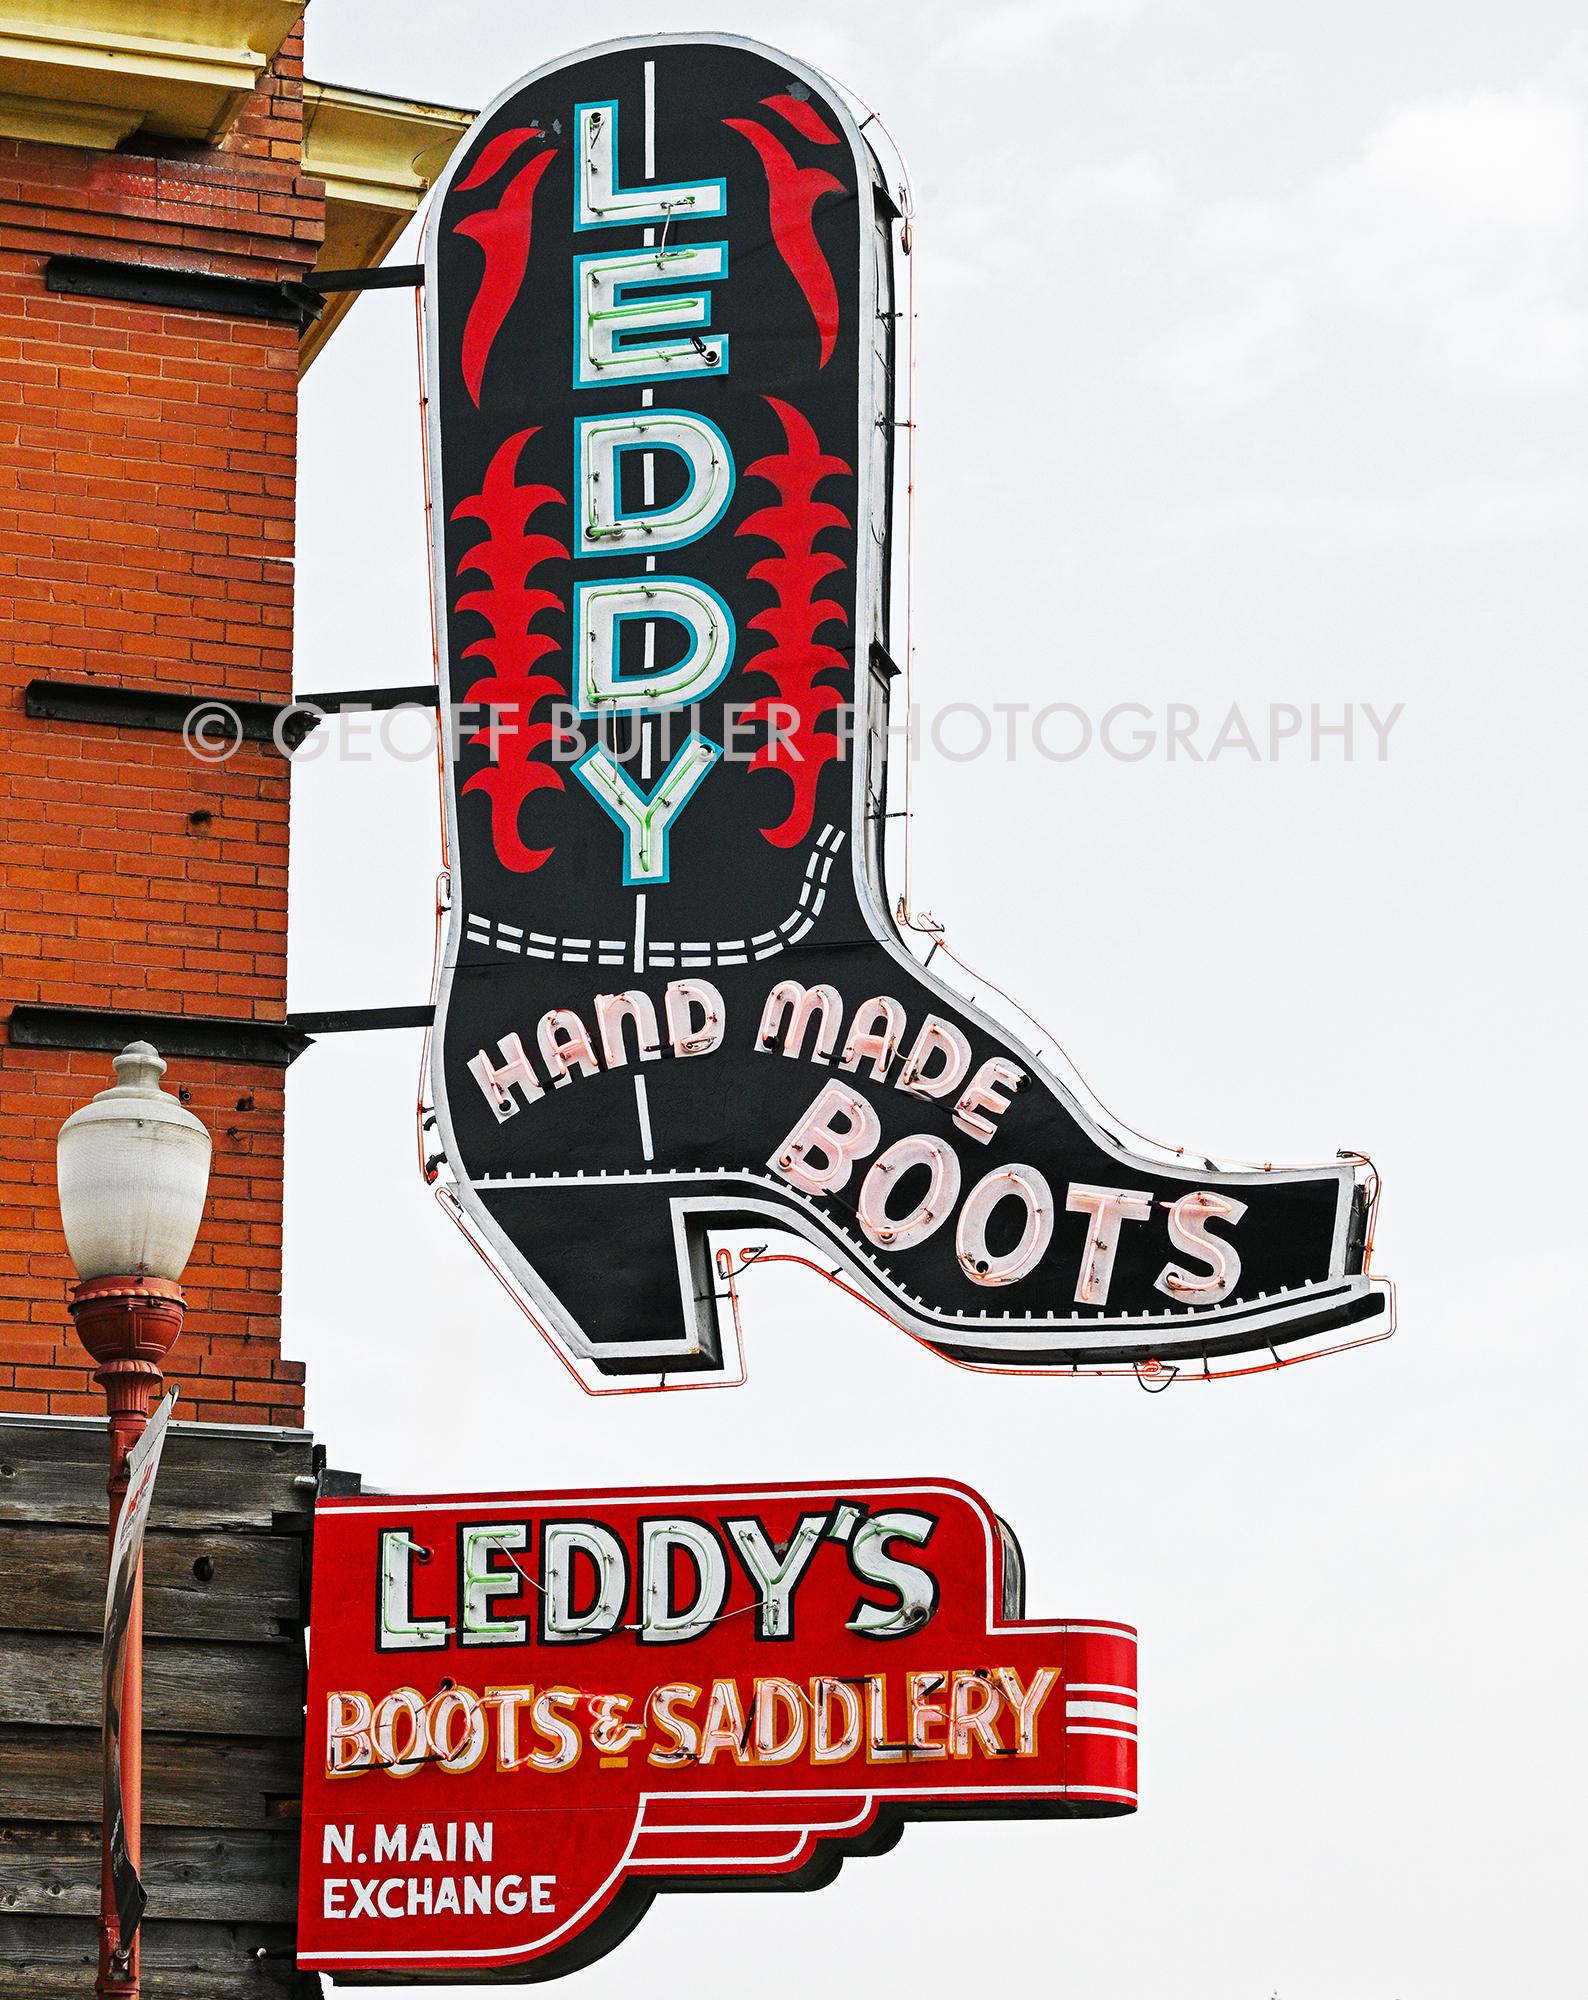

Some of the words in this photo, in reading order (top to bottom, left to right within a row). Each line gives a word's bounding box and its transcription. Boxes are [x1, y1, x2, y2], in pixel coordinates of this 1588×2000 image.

[571, 99, 737, 886] LEDDY
[466, 977, 726, 1124] HAND
[754, 980, 1031, 1145] MADE
[765, 1078, 1249, 1308] BOOTS
[376, 1498, 939, 1653] LEDDY'S
[326, 1680, 583, 1780] BOOTS
[588, 1695, 646, 1769] &
[648, 1667, 1062, 1766] SADDLERY
[323, 1875, 557, 1919] EXCHANGE
